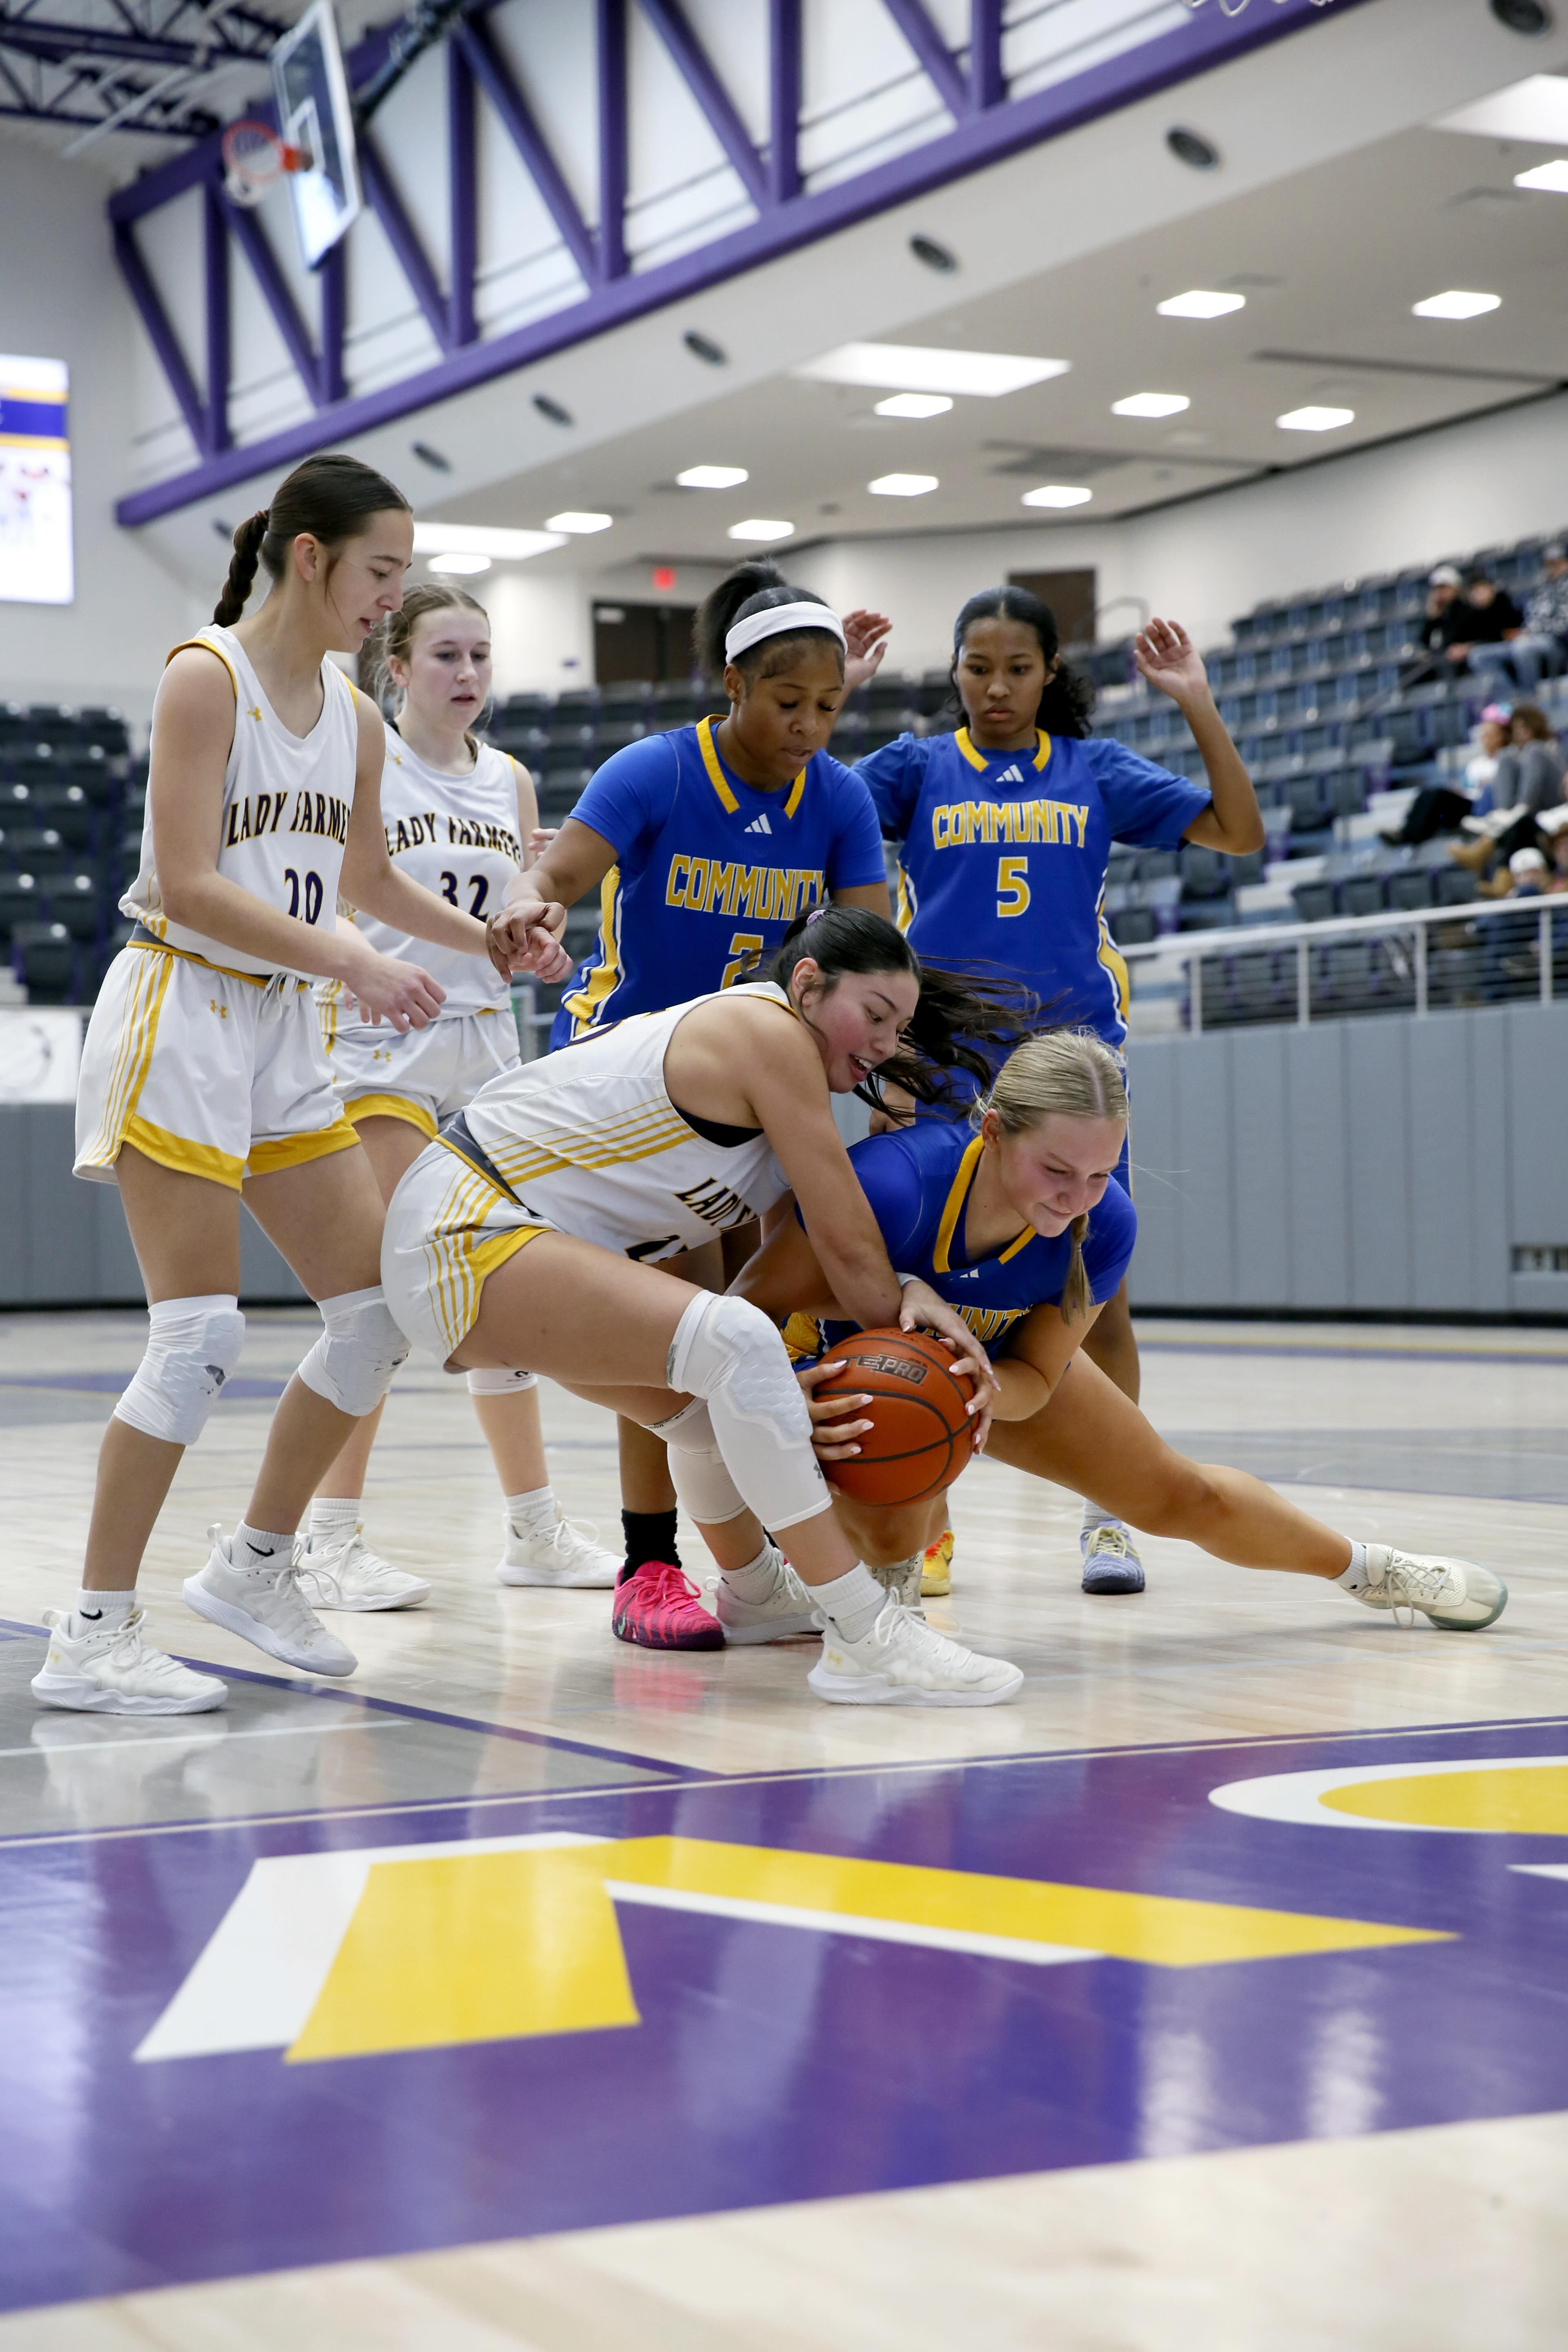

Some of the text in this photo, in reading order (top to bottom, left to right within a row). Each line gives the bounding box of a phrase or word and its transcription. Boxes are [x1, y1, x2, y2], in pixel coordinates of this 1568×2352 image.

[225, 791, 288, 849] LADY
[385, 812, 436, 857] LADY
[932, 799, 1089, 850] COMMUNITY
[284, 867, 323, 926] 20
[440, 870, 490, 923] 32
[996, 856, 1031, 918] 5
